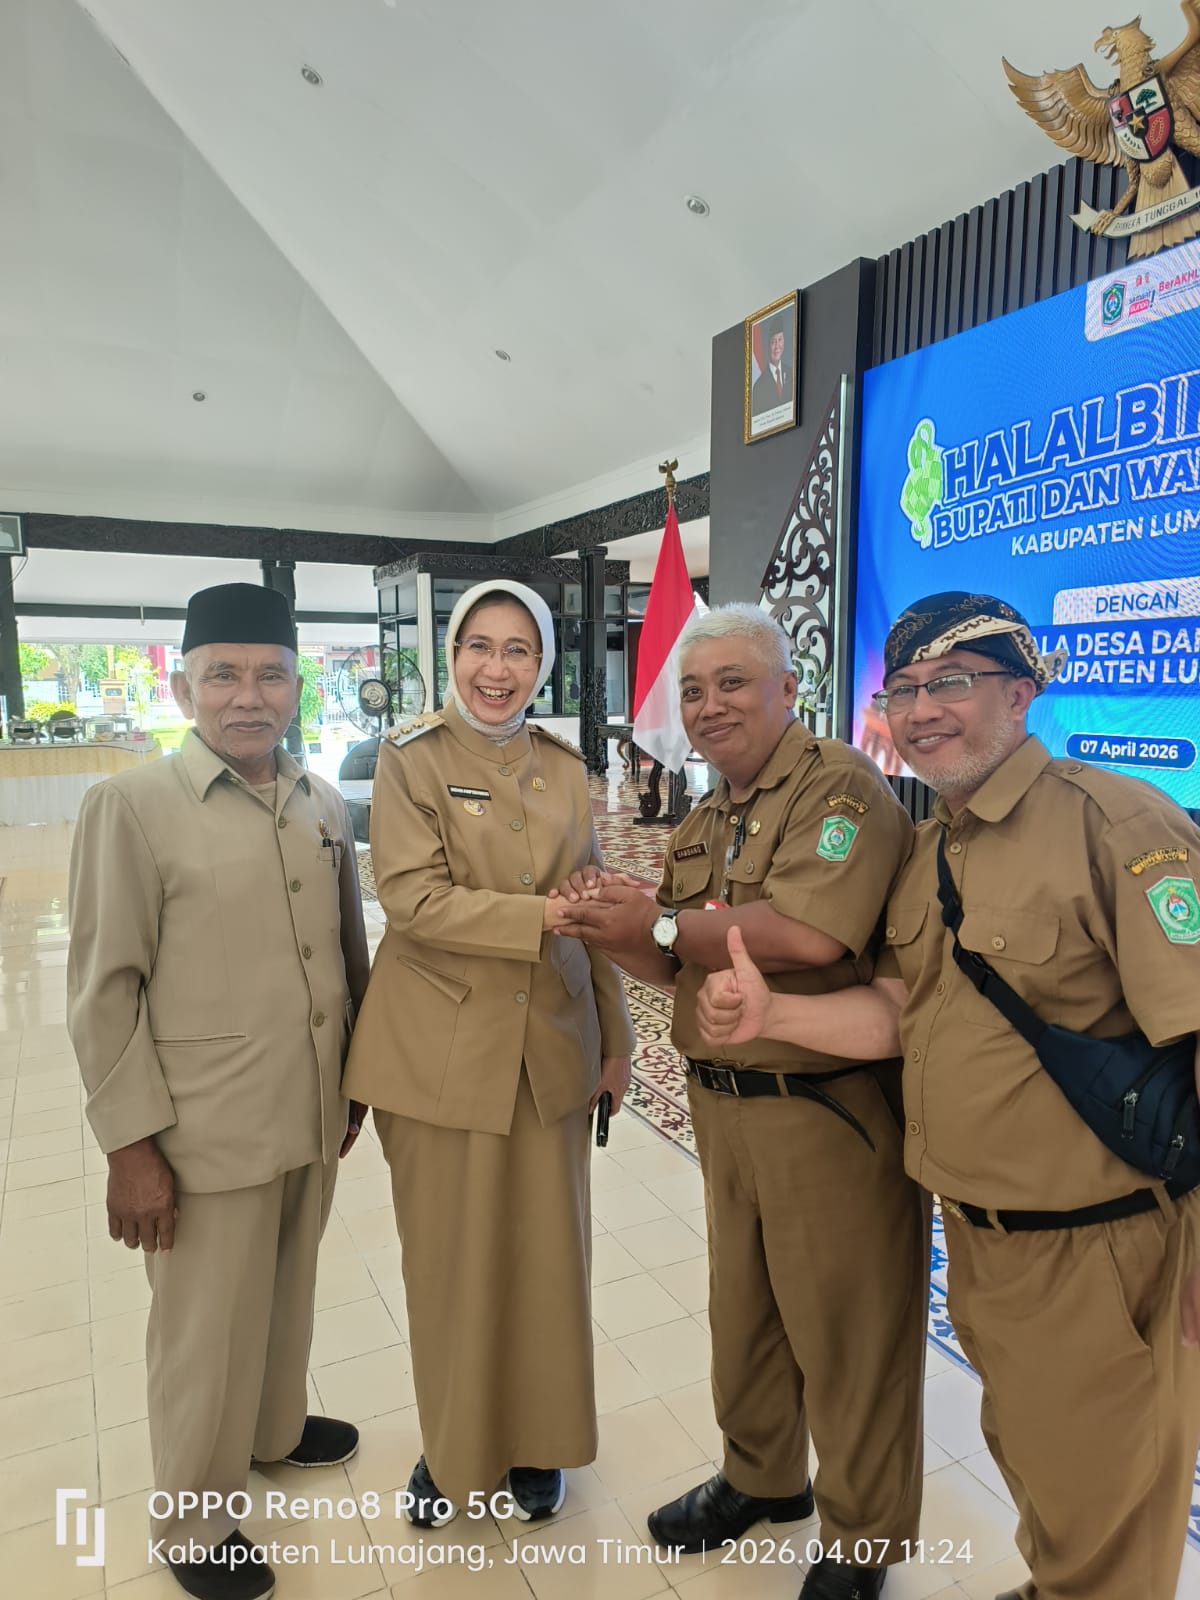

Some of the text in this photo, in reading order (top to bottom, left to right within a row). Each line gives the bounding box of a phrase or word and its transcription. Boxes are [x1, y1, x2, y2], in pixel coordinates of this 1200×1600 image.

[933, 446, 1200, 548] BUPATI DAN WA
[1011, 516, 1144, 556] KABUPATEN
[1095, 591, 1179, 614] DENGAN
[1076, 631, 1145, 656] DESA
[1048, 658, 1200, 684] UPATEN LU
[1080, 739, 1179, 759] 07 April 2026
